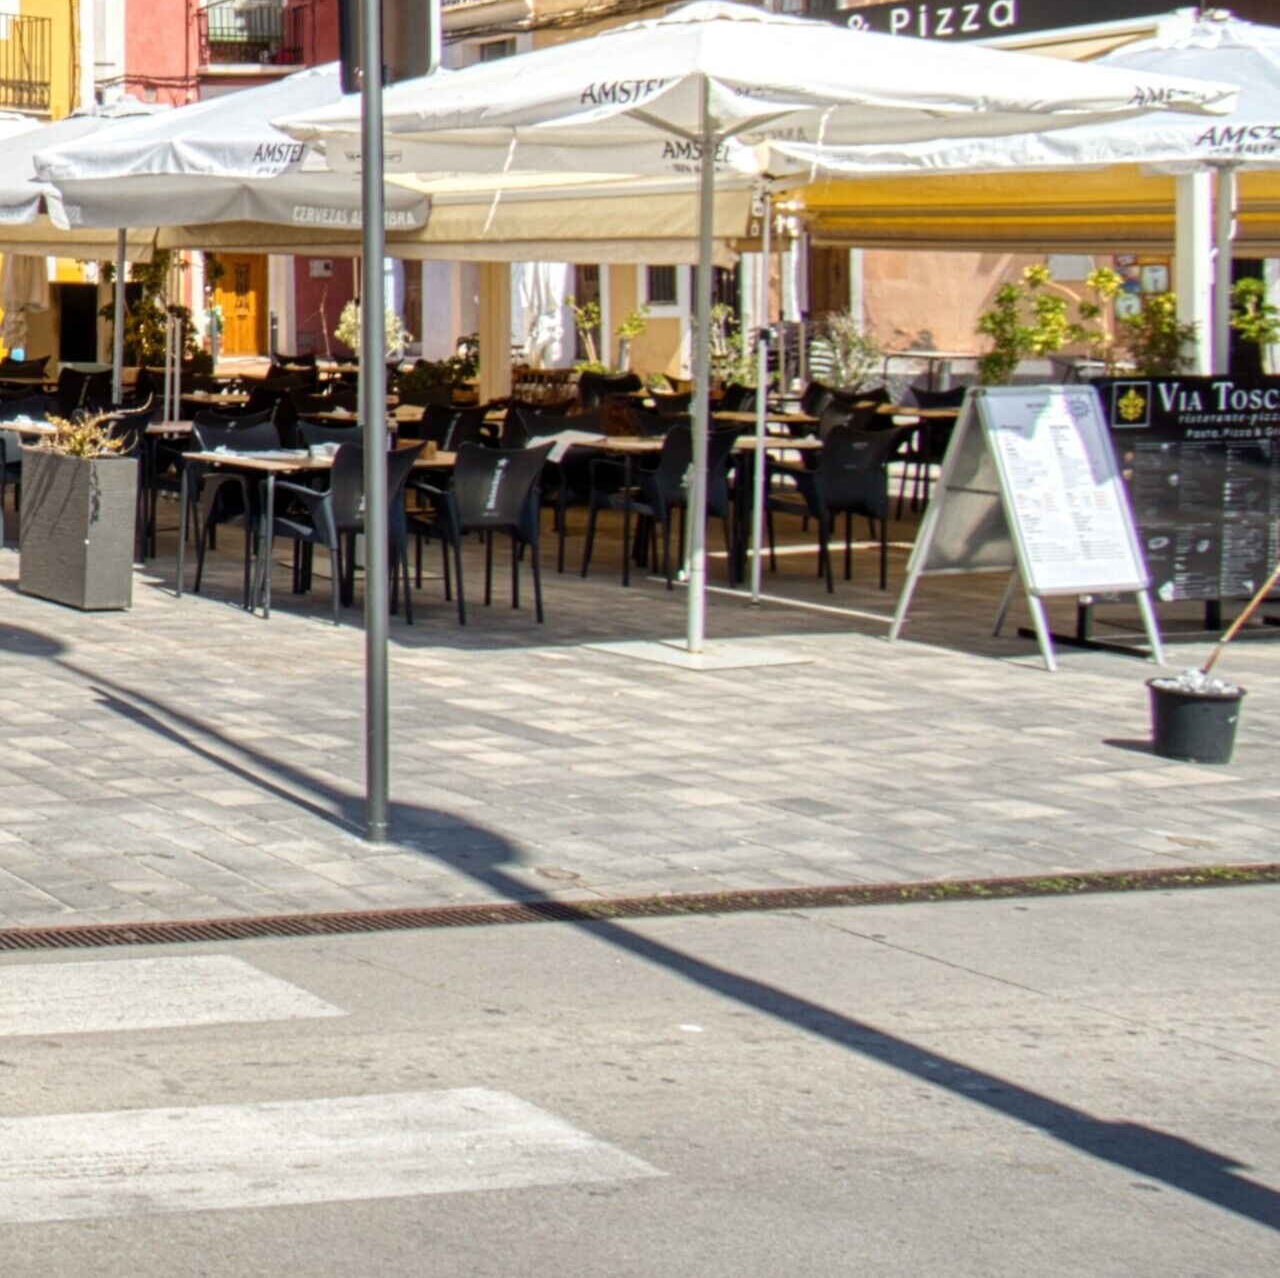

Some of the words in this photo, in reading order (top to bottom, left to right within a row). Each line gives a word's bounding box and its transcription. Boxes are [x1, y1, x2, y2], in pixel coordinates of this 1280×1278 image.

[662, 140, 734, 164] AMSEL
[292, 206, 348, 224] CERVEZAS
[1212, 381, 1280, 411] TOSC
